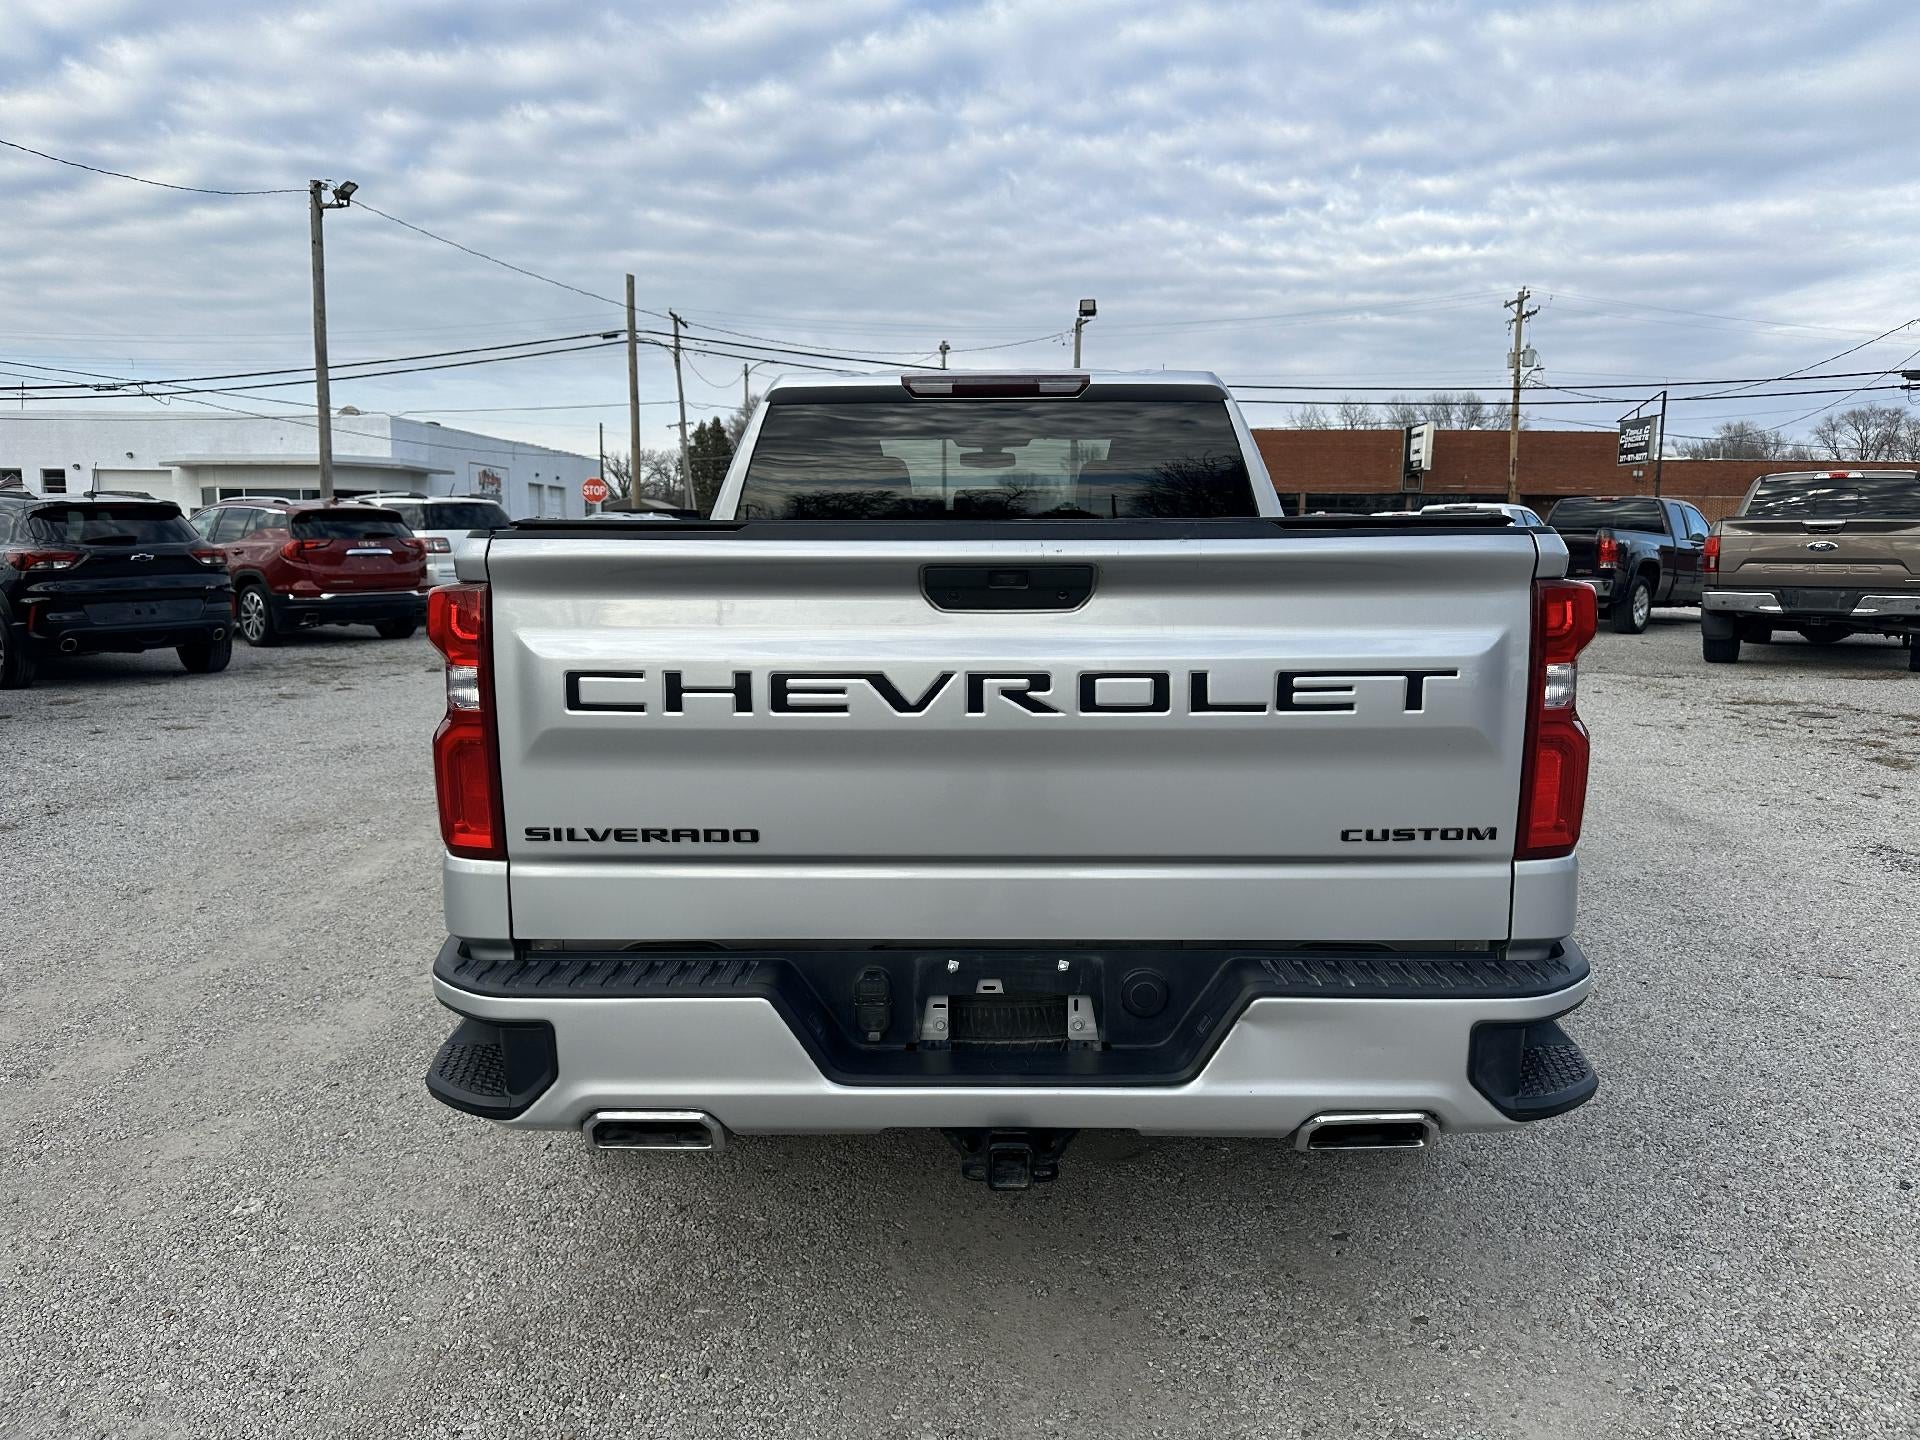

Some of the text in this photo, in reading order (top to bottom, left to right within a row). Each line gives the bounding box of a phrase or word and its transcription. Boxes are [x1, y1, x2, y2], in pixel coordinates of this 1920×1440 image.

[1644, 425, 1650, 434] C
[583, 485, 606, 495] STOP
[564, 669, 1461, 716] CHEVROLET
[524, 827, 760, 843] SILVERADO
[1340, 827, 1498, 842] CUSTOM
